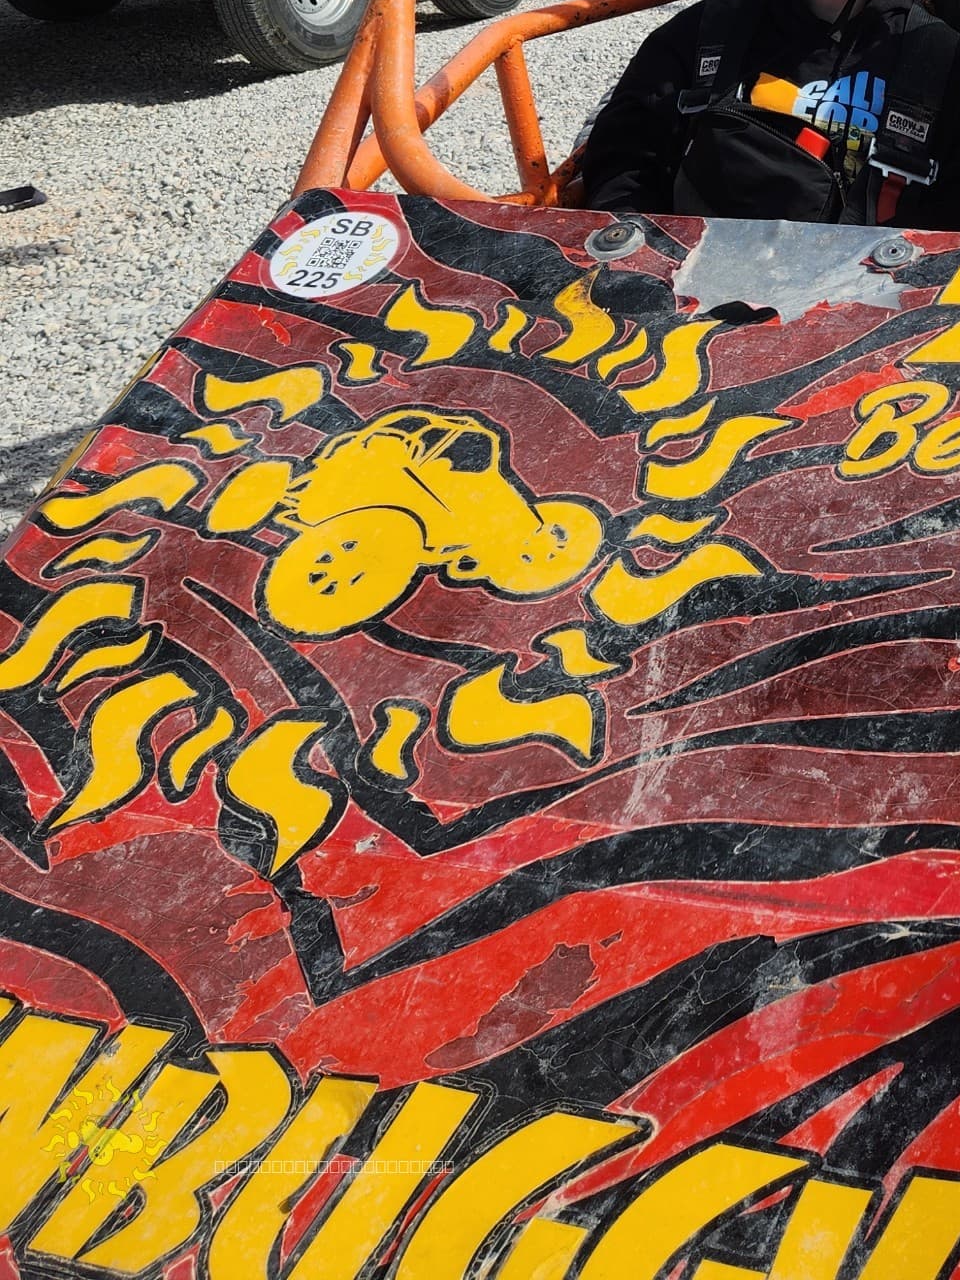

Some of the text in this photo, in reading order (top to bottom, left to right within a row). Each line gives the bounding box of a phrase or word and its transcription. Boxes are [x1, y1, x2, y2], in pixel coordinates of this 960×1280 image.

[799, 71, 885, 115] CALI
[889, 114, 917, 130] CROW
[331, 218, 374, 237] SB
[286, 269, 342, 289] 225
